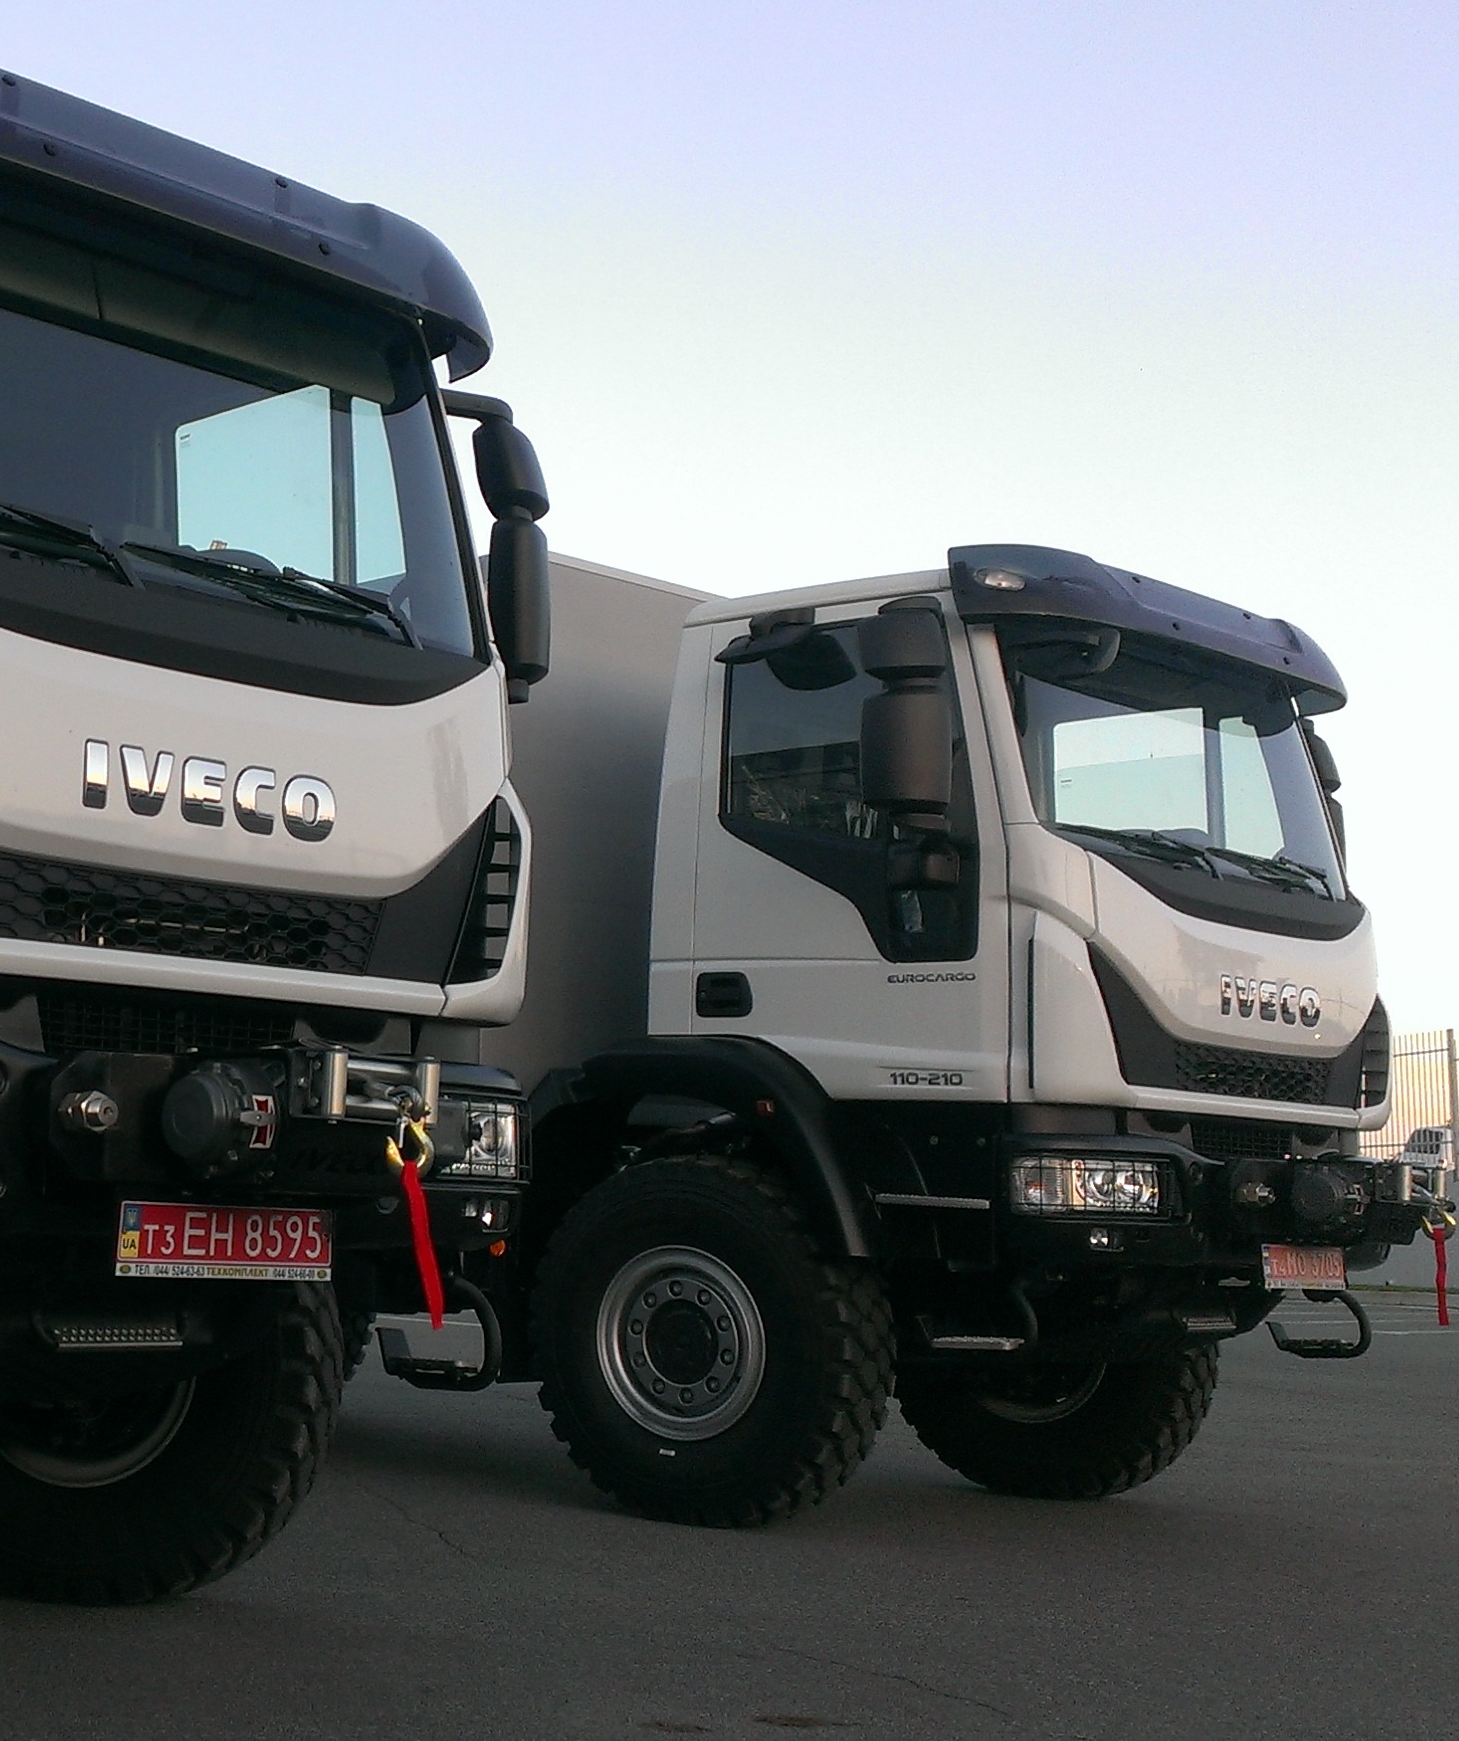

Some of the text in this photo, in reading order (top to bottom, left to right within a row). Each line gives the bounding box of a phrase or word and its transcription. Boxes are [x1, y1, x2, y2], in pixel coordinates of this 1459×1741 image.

[82, 738, 337, 842] IVECO
[887, 972, 977, 984] EUROCARGO
[1221, 974, 1321, 1028] IVECO
[889, 1072, 964, 1086] 110-210
[122, 1238, 137, 1250] UA
[244, 1214, 323, 1259] 8595
